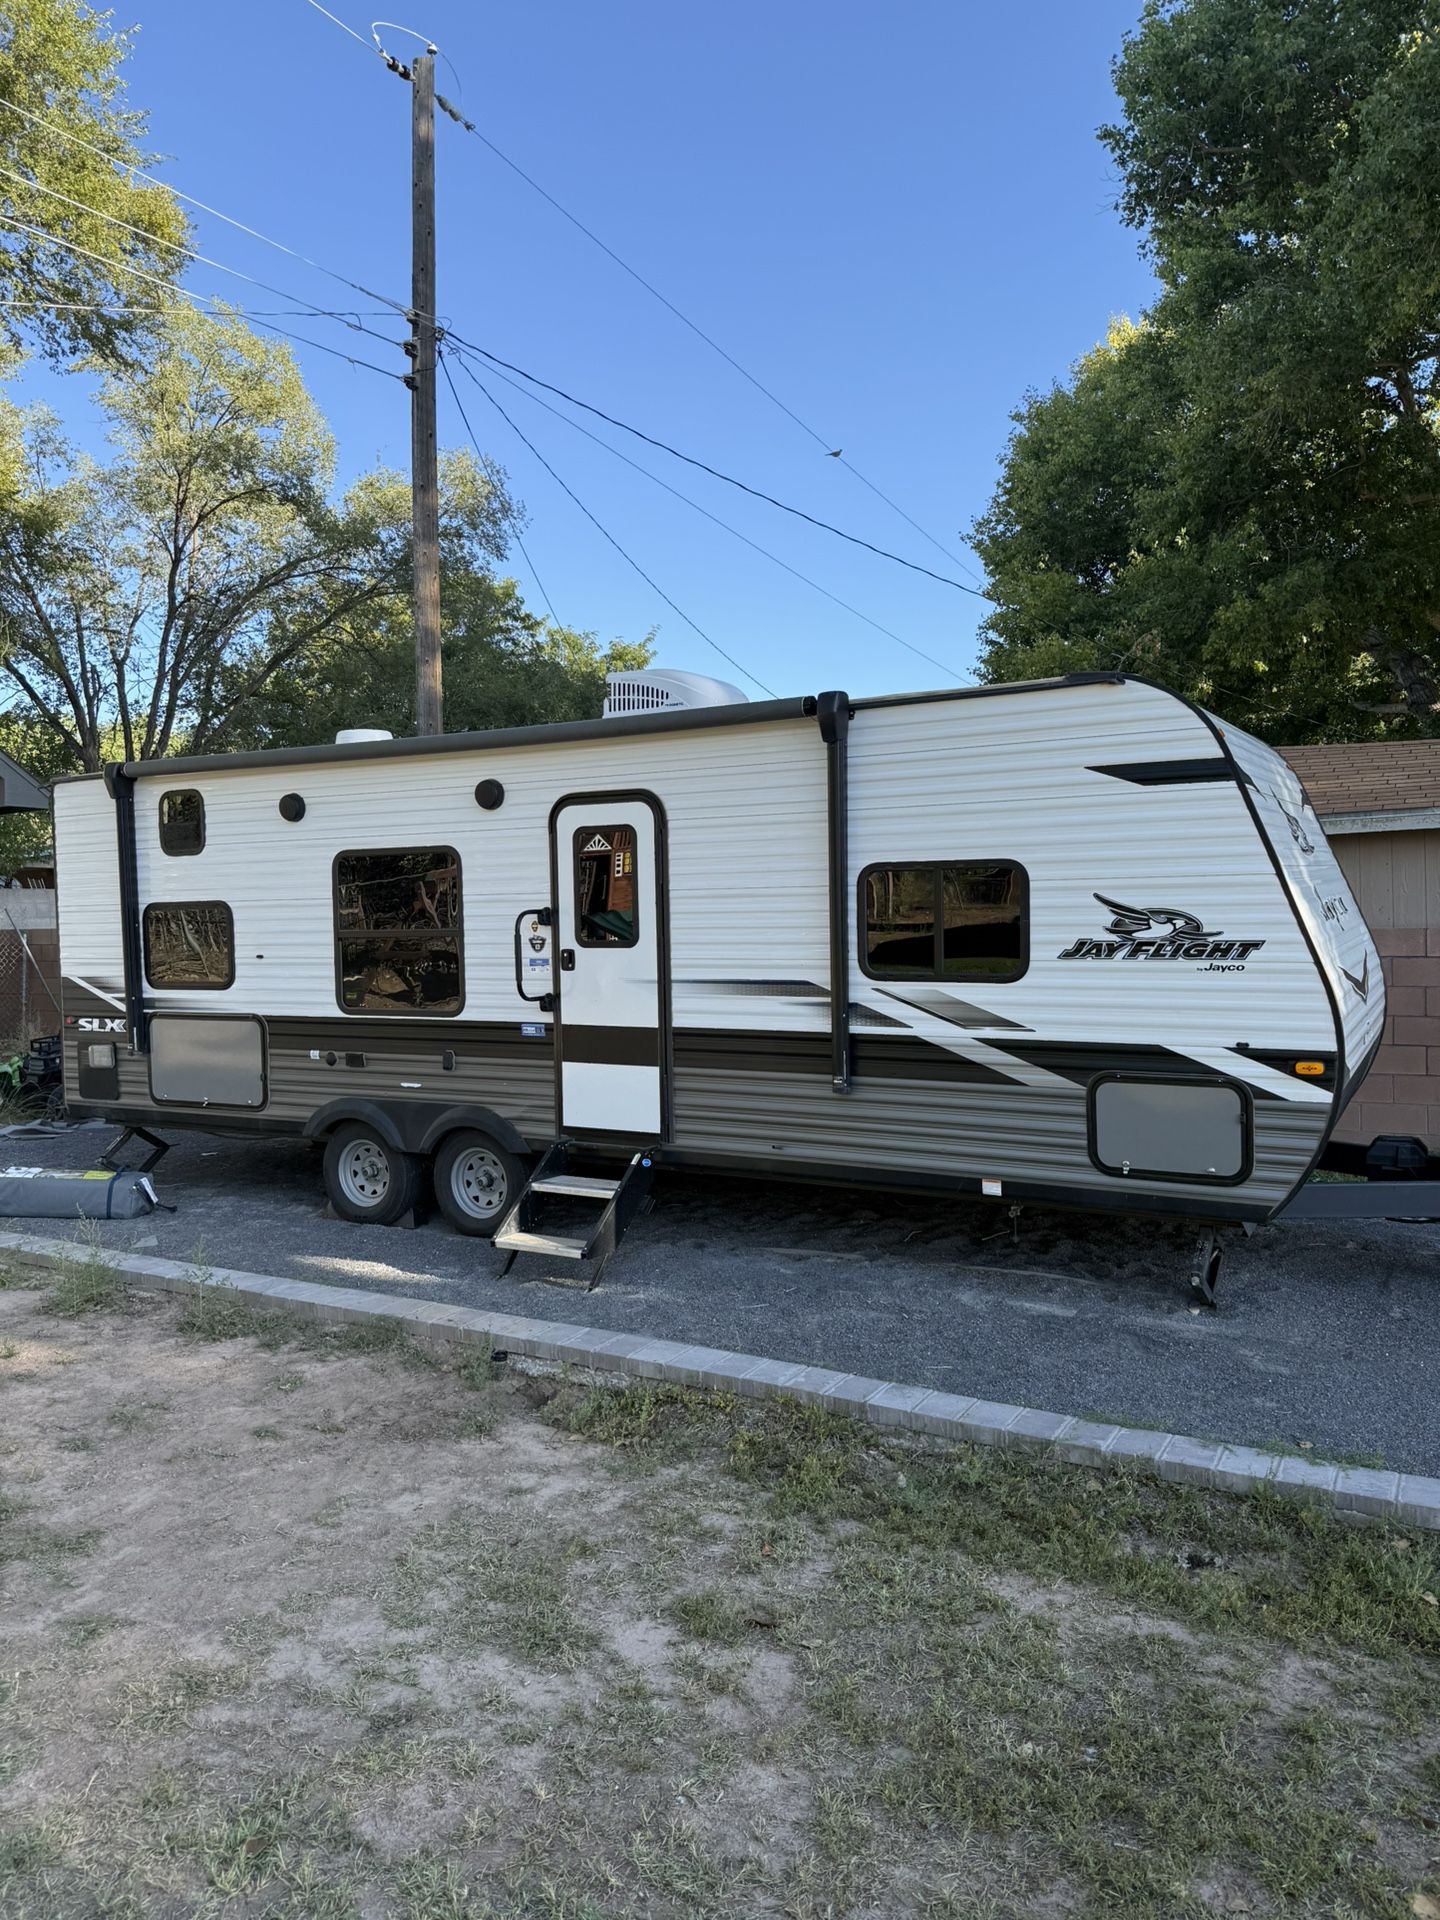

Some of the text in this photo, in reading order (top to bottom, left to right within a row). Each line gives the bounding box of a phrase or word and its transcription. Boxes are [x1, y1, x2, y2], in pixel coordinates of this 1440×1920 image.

[1057, 938, 1266, 960] JAY FLIGHT
[1203, 962, 1245, 973] Jayco
